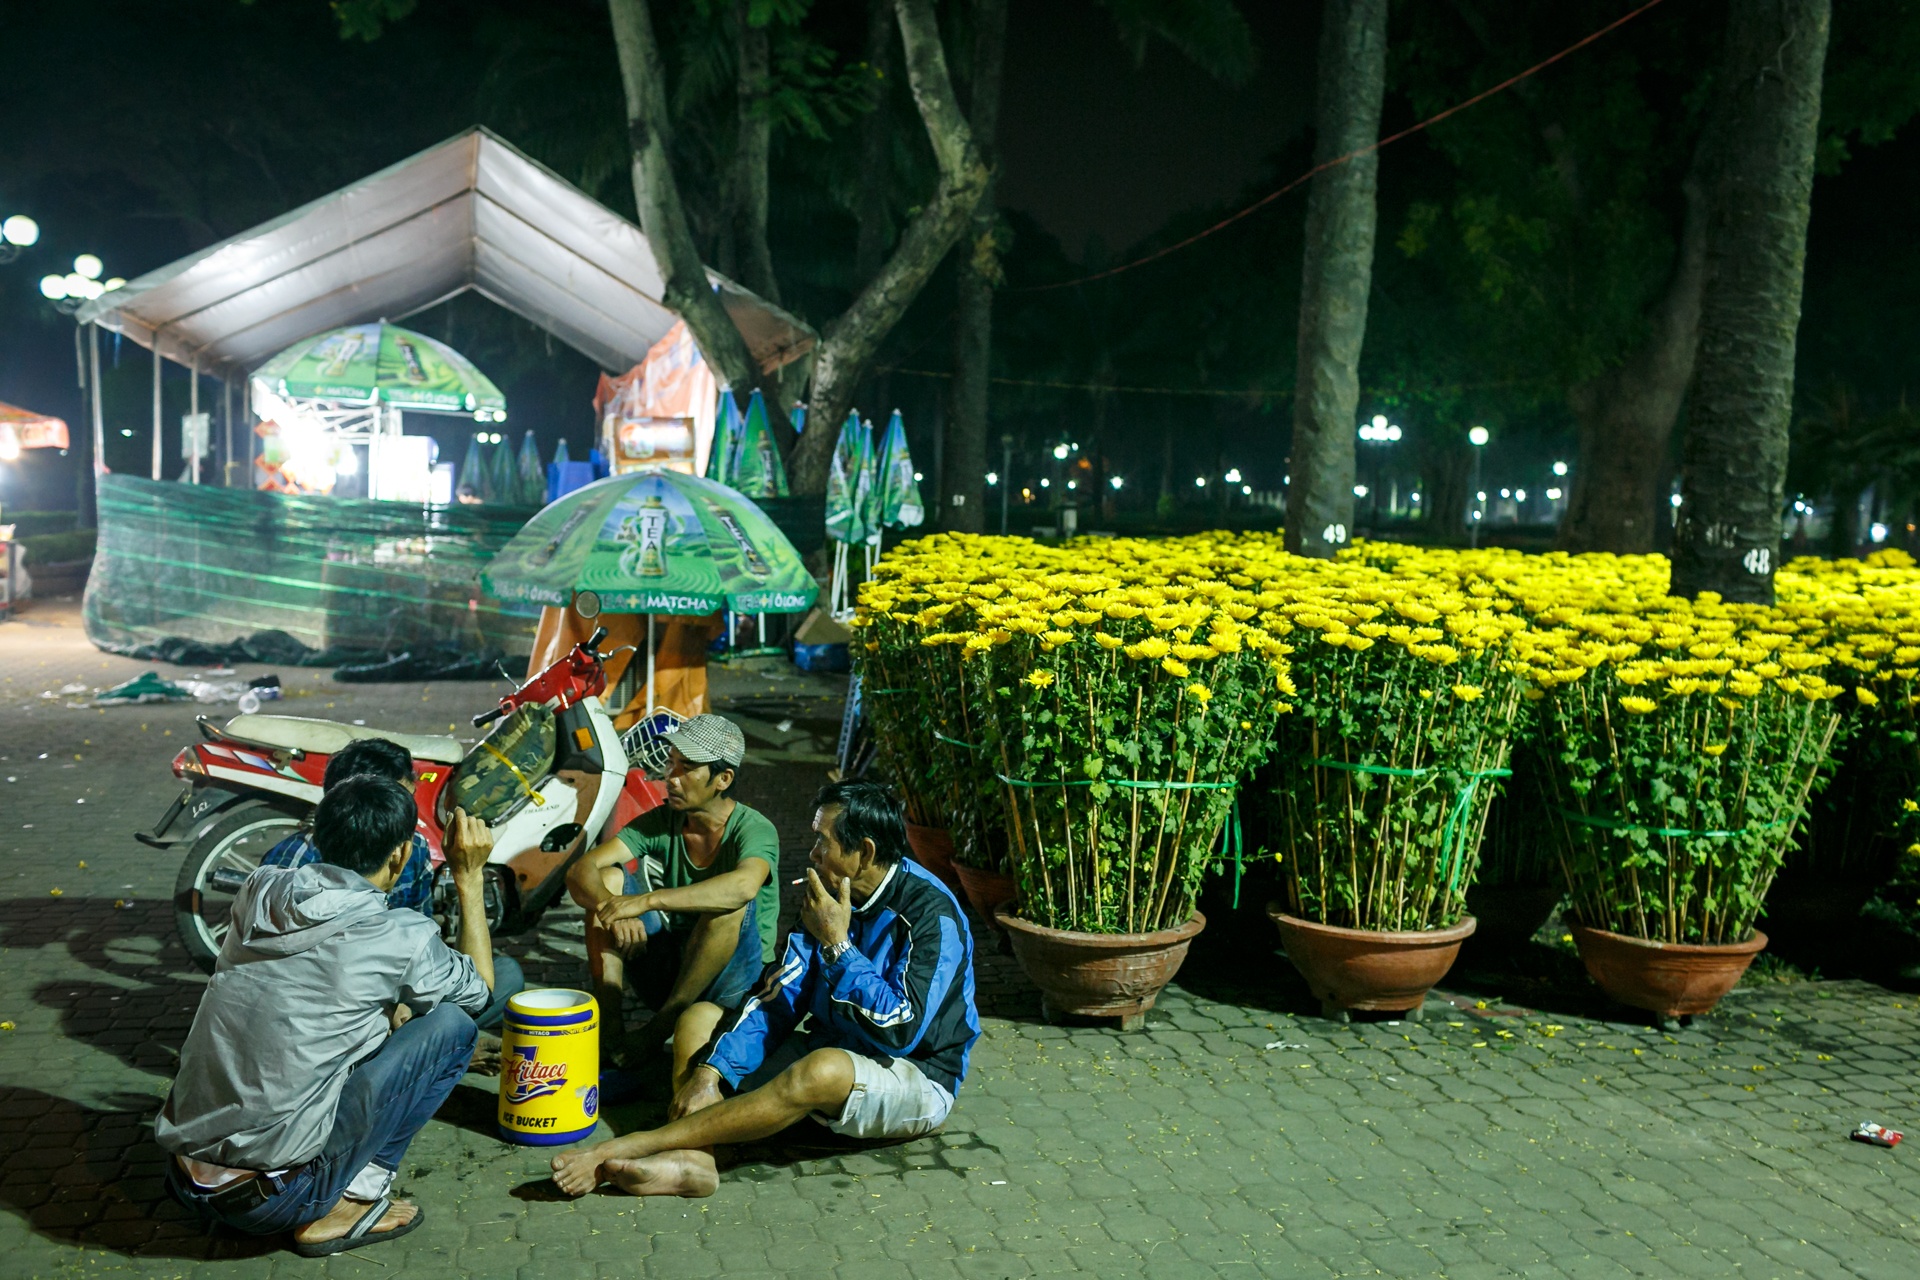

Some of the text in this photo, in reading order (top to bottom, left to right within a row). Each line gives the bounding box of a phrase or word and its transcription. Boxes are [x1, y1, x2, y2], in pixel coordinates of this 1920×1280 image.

[646, 515, 659, 551] TEA
[720, 516, 754, 552] TEA
[1323, 523, 1346, 544] 49
[1743, 548, 1770, 574] 48
[647, 592, 709, 610] MATCHA
[503, 1057, 567, 1086] Hitaco
[503, 1111, 558, 1128] ICE BUCKET
